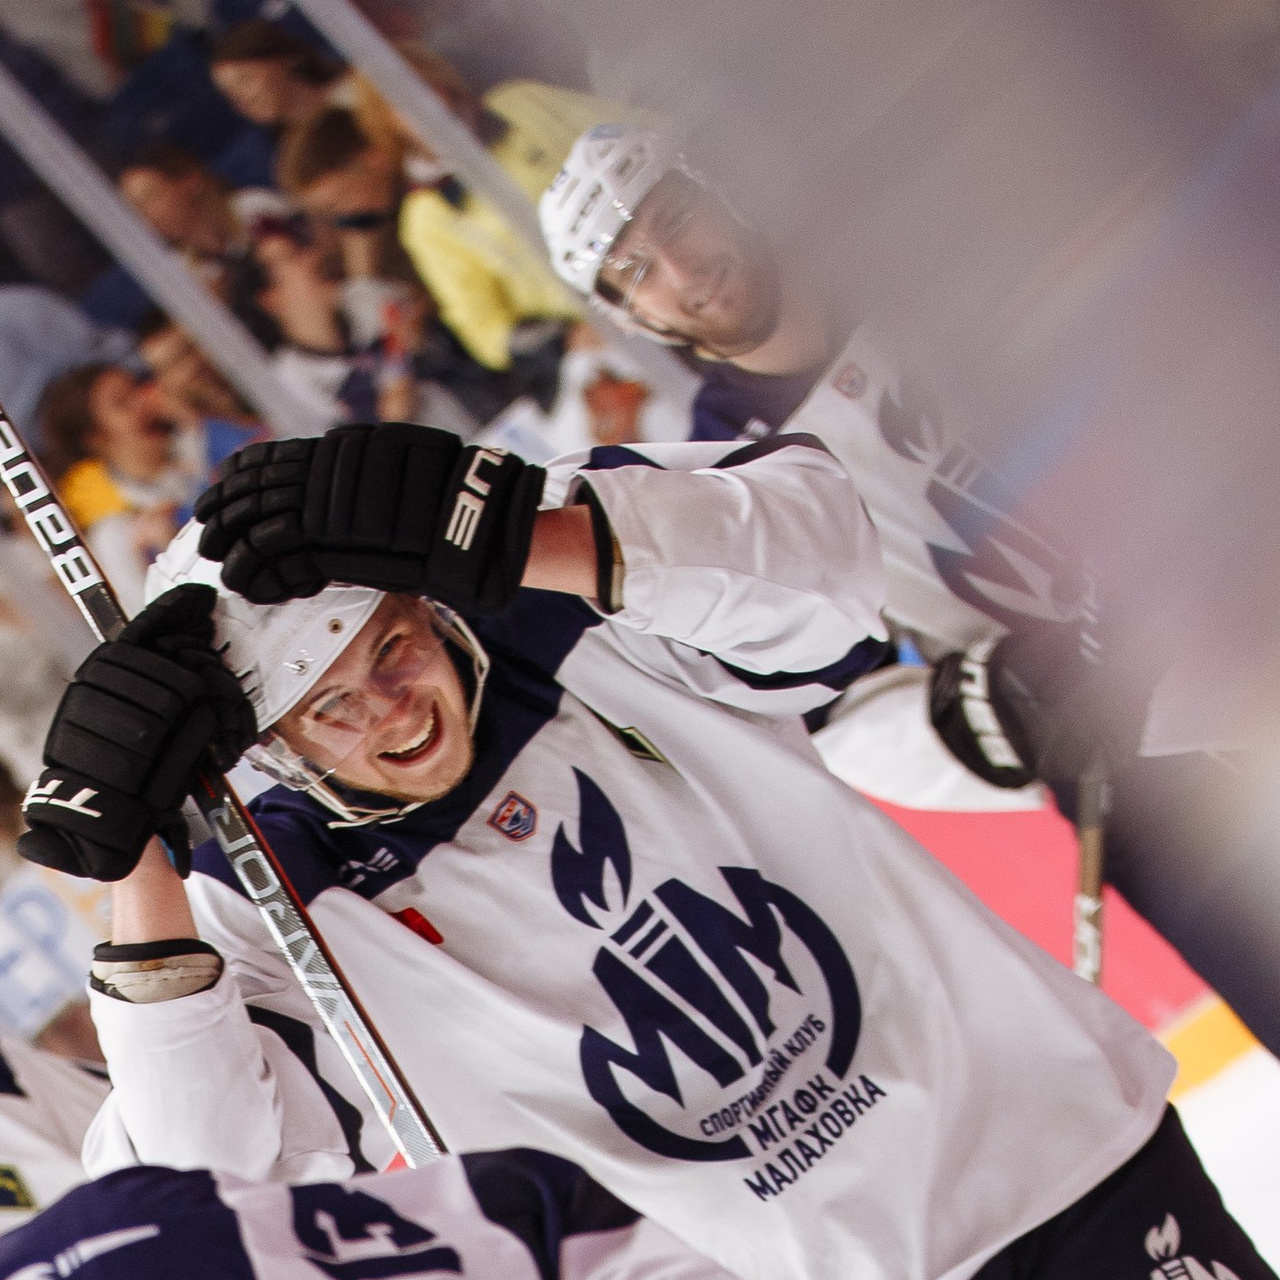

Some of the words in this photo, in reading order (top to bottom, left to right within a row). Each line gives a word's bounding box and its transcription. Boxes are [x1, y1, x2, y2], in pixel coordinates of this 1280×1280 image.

[784, 1013, 827, 1057] КЛУБ
[743, 1074, 888, 1202] МАЛАХОВКА
[748, 1074, 837, 1152] МГАФК
